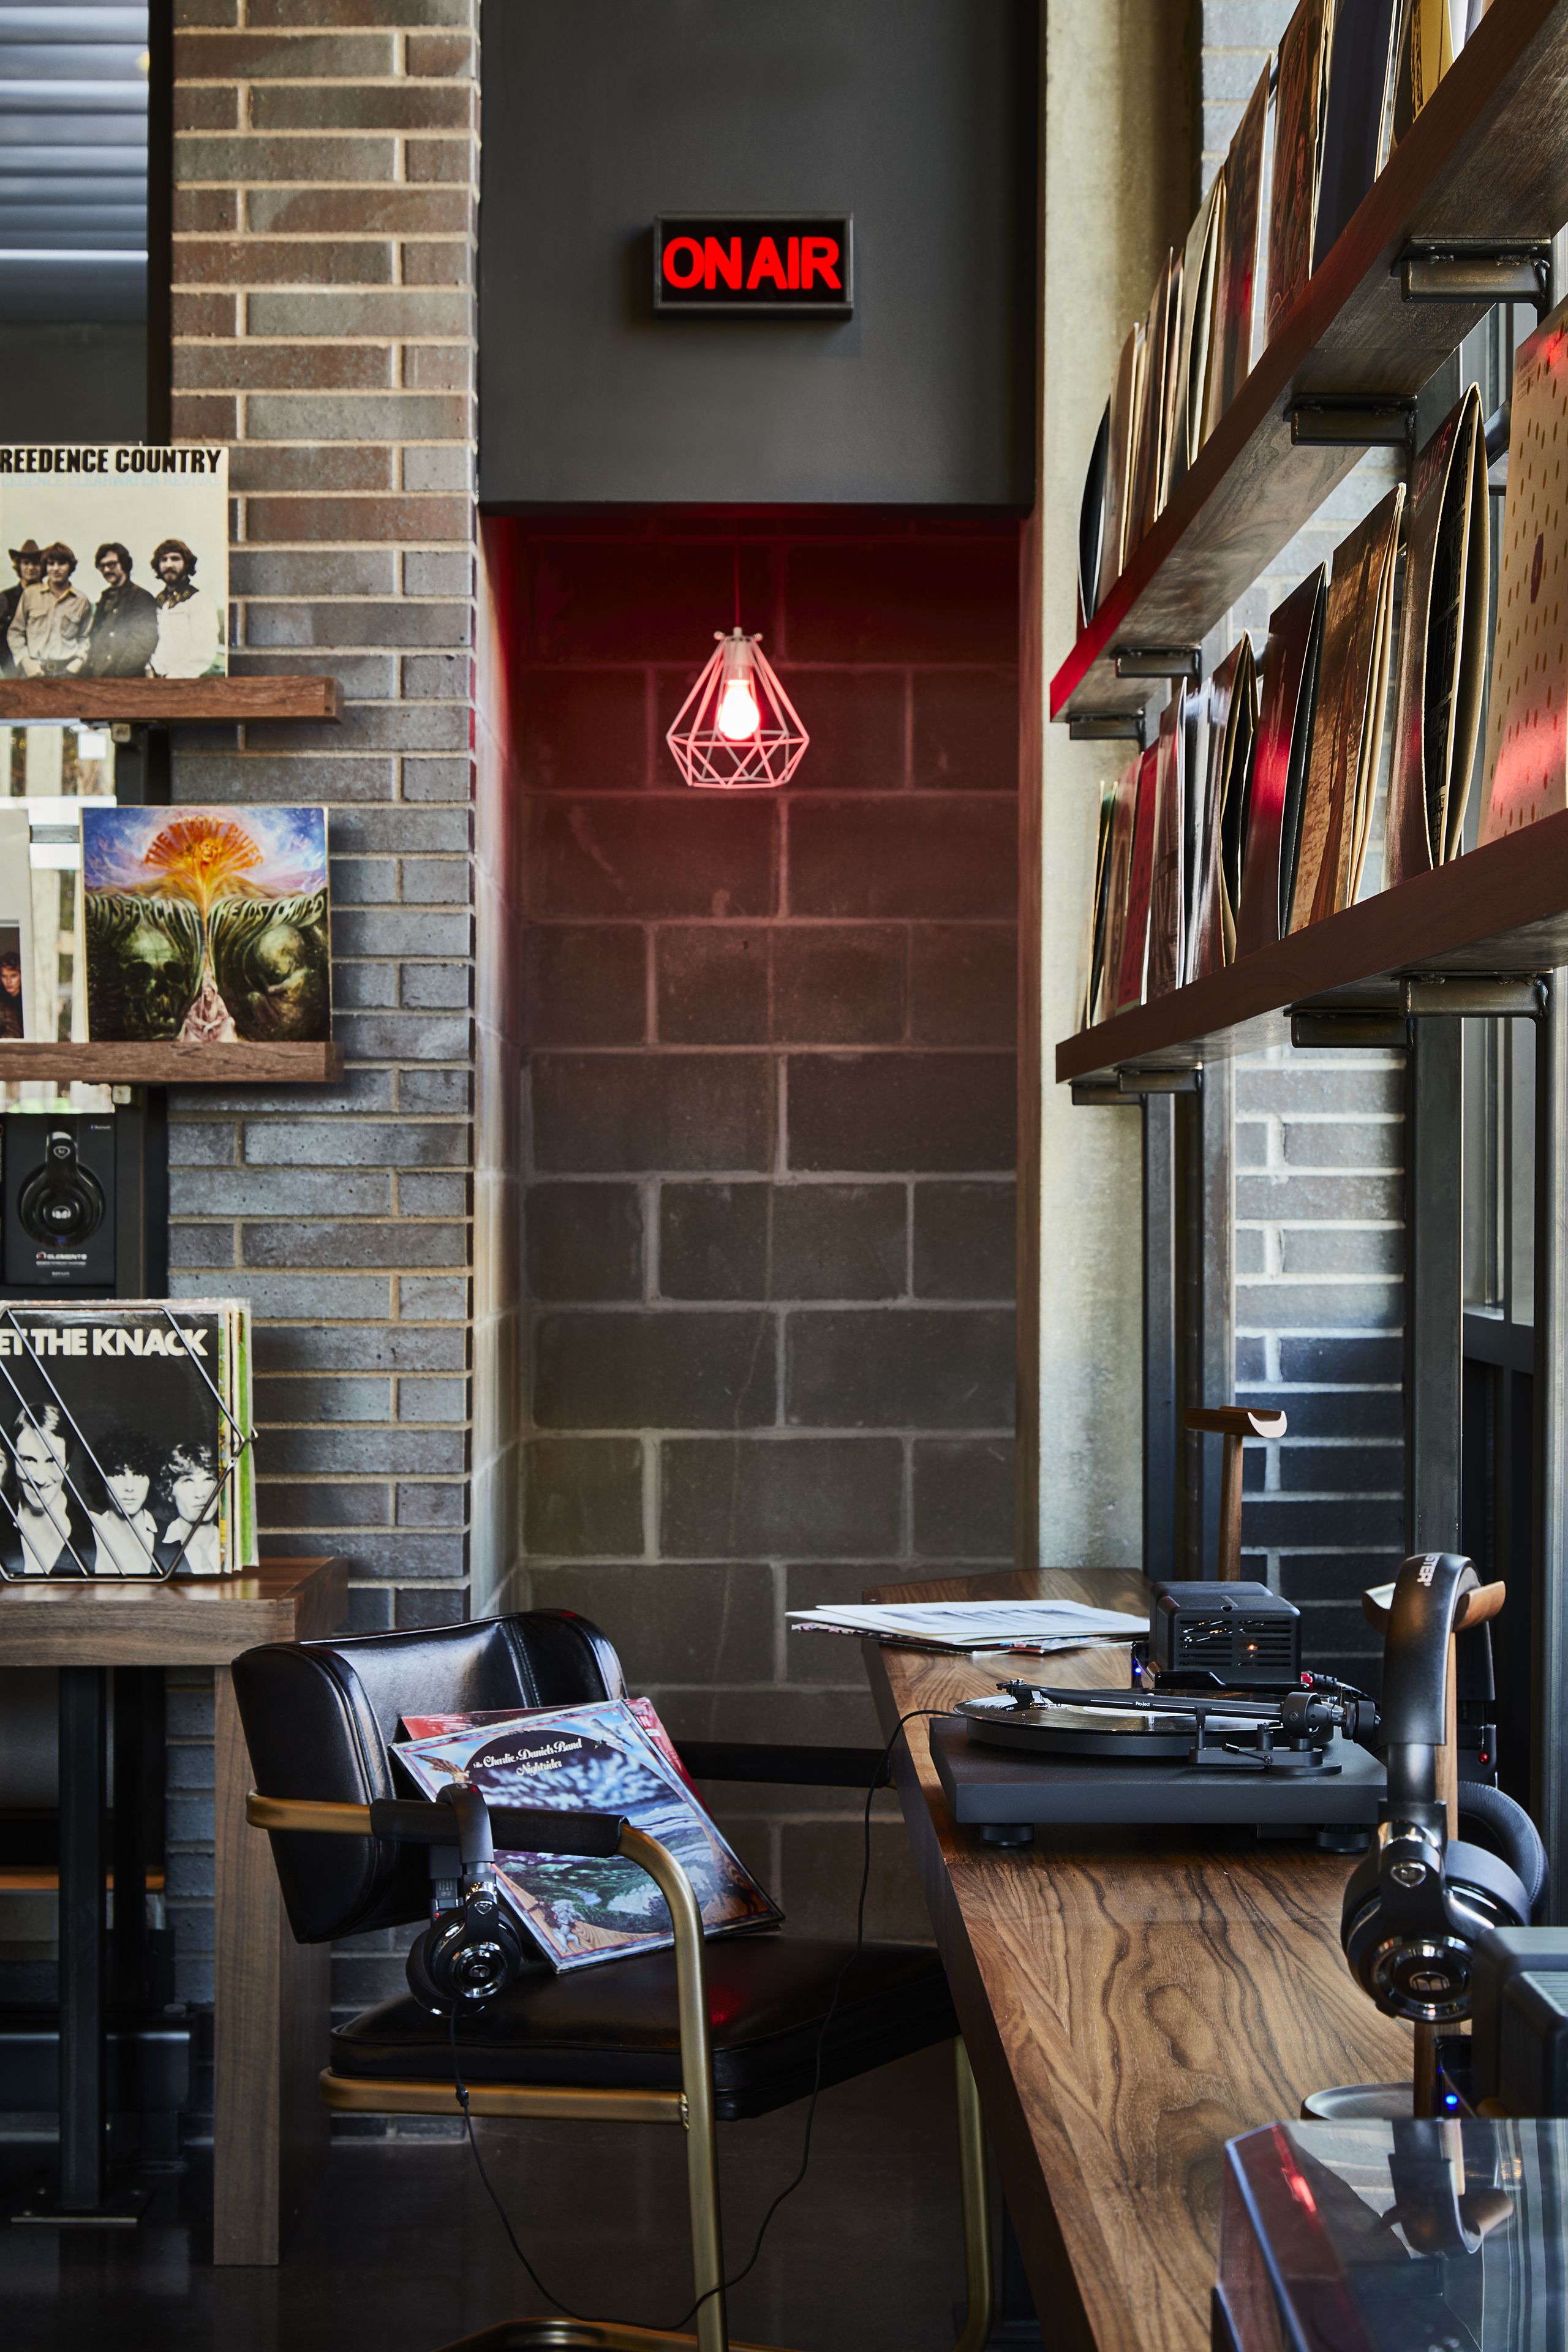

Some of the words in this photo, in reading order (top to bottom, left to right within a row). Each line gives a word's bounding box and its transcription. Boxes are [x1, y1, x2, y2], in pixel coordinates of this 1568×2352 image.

[663, 236, 742, 290] ON
[746, 236, 842, 290] AIR
[0, 448, 108, 473] REEDENCE
[115, 448, 222, 473] COUNTRY
[1415, 421, 1452, 505] ELVIS
[68, 474, 159, 487] CLEARWATER
[164, 474, 221, 487] REVIVAL
[144, 831, 168, 864] THE
[224, 823, 264, 865] BLUES
[111, 895, 176, 925] SEARCH
[30, 1328, 88, 1356] THE
[92, 1328, 209, 1356] KNACK
[483, 1753, 518, 1768] Charlie
[518, 1744, 554, 1761] Daniels
[553, 1737, 582, 1754] Band
[516, 1758, 563, 1777] Nightrider
